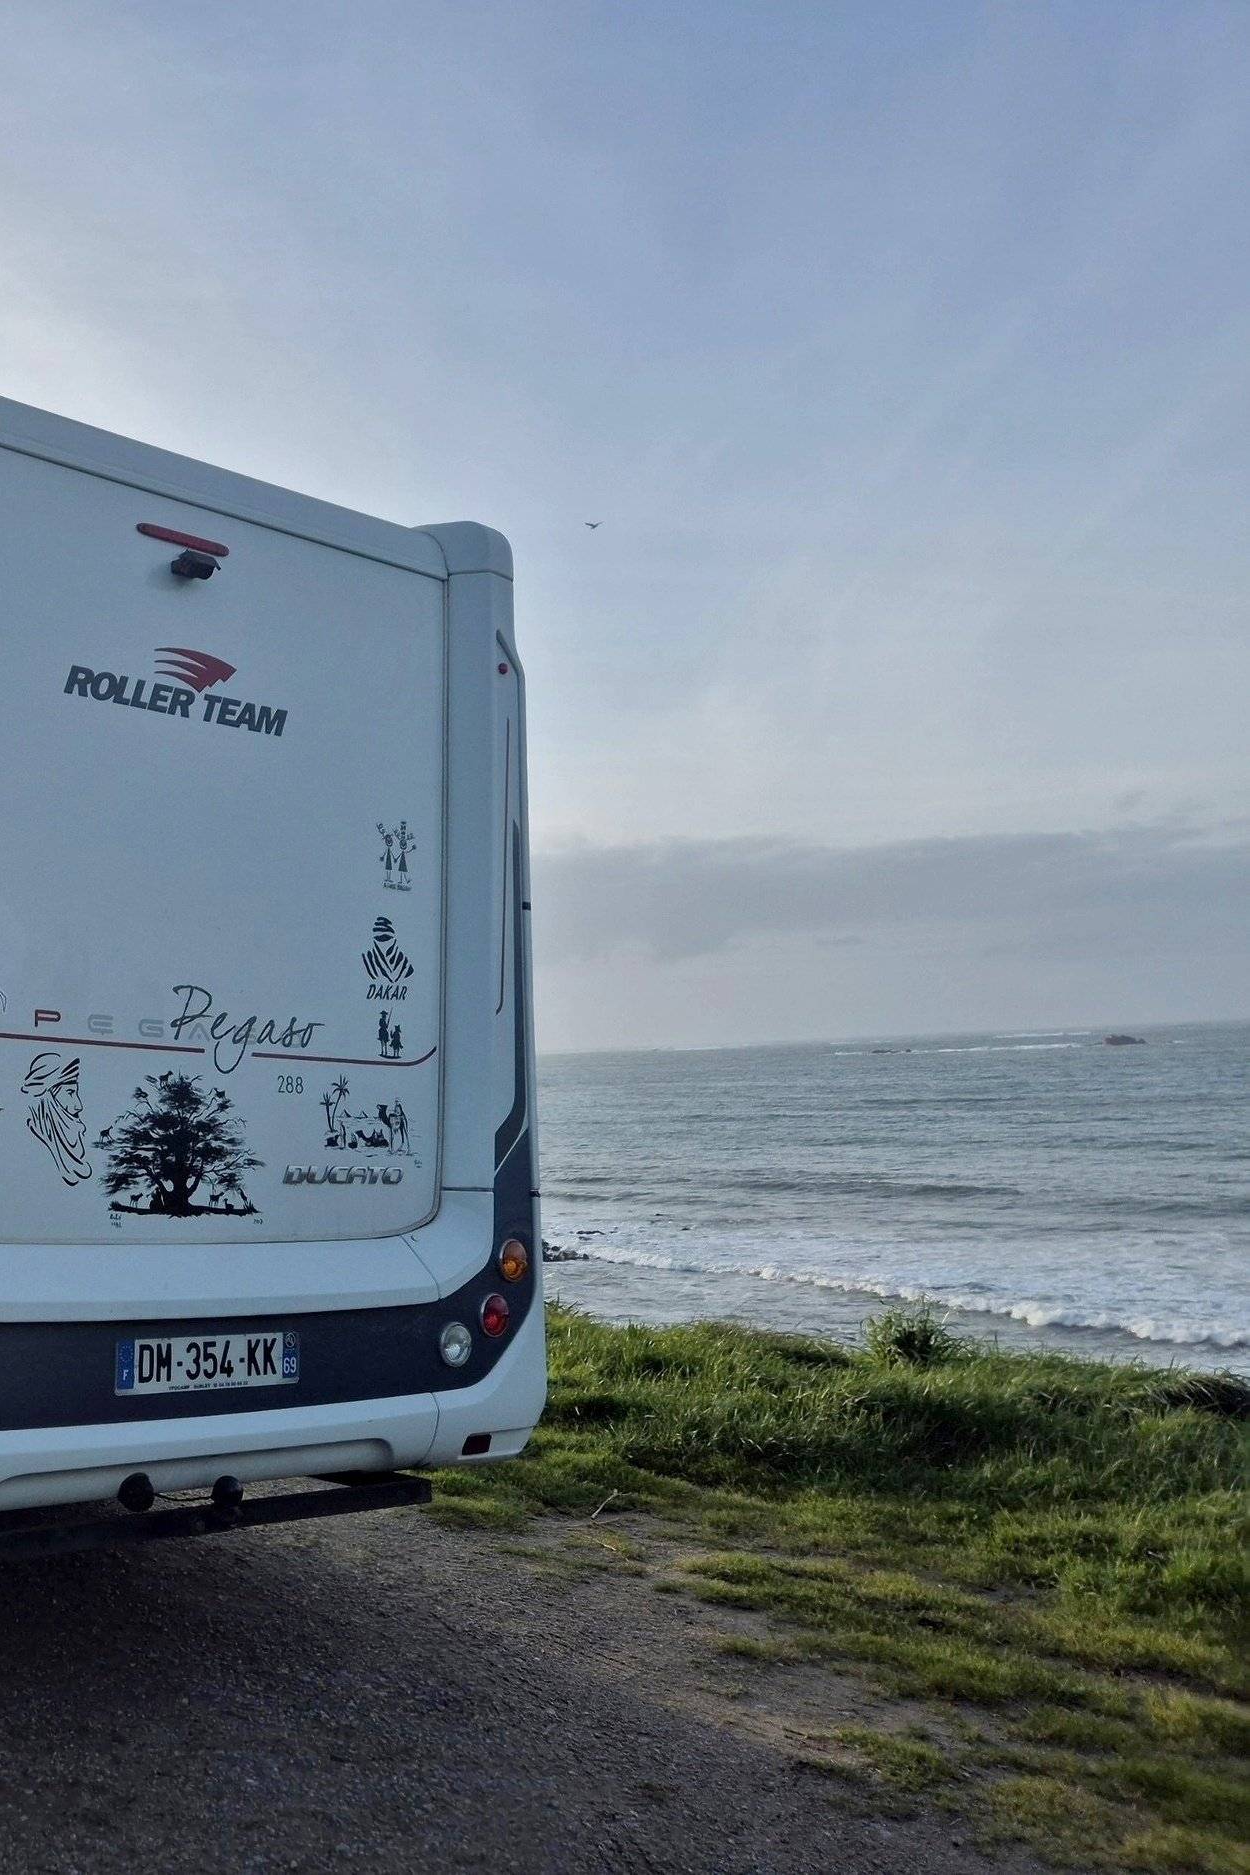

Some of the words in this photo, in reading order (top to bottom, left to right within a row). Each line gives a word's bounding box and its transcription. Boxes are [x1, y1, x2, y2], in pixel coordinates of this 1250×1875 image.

[63, 664, 196, 719] ROLLER
[202, 693, 288, 737] TEAM
[366, 983, 409, 1000] DAKAR
[170, 984, 326, 1074] Pegaso
[277, 1075, 304, 1095] 288
[282, 1164, 404, 1186] DUCATO
[122, 1369, 129, 1381] F
[283, 1356, 298, 1375] 69
